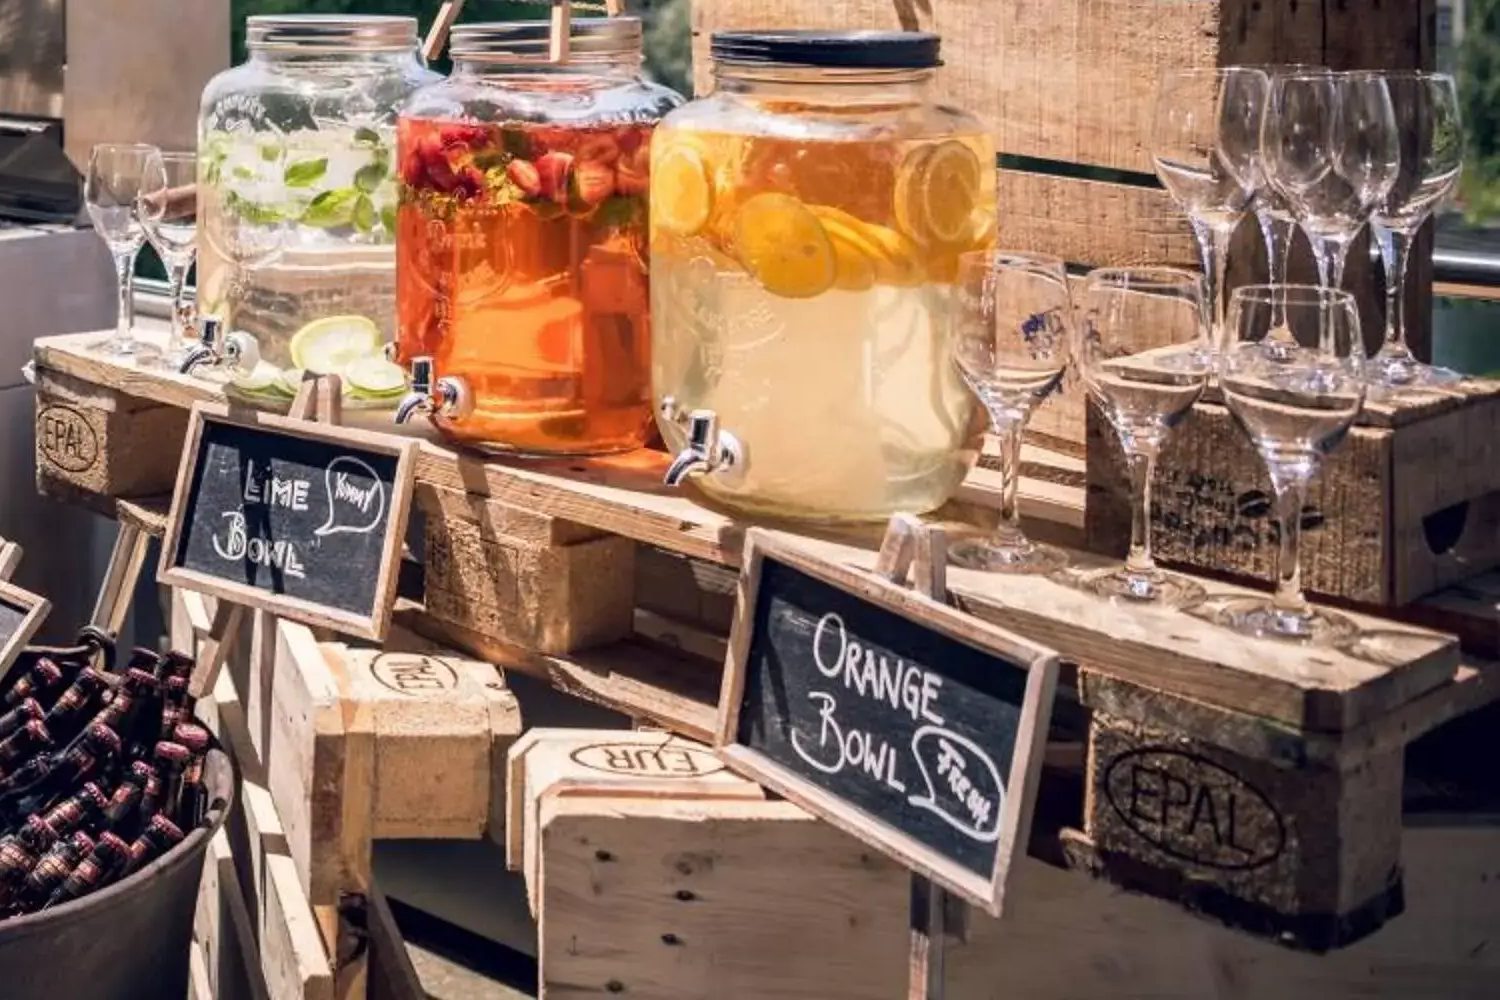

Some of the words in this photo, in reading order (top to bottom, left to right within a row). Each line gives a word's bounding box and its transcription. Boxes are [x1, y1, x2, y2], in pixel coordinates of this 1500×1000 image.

[44, 414, 87, 461] EPAL
[212, 510, 307, 579] BOWL
[813, 611, 945, 726] ORANGE
[602, 748, 699, 773] EUR
[791, 691, 906, 794] BOWL
[1132, 765, 1255, 857] EPAL
